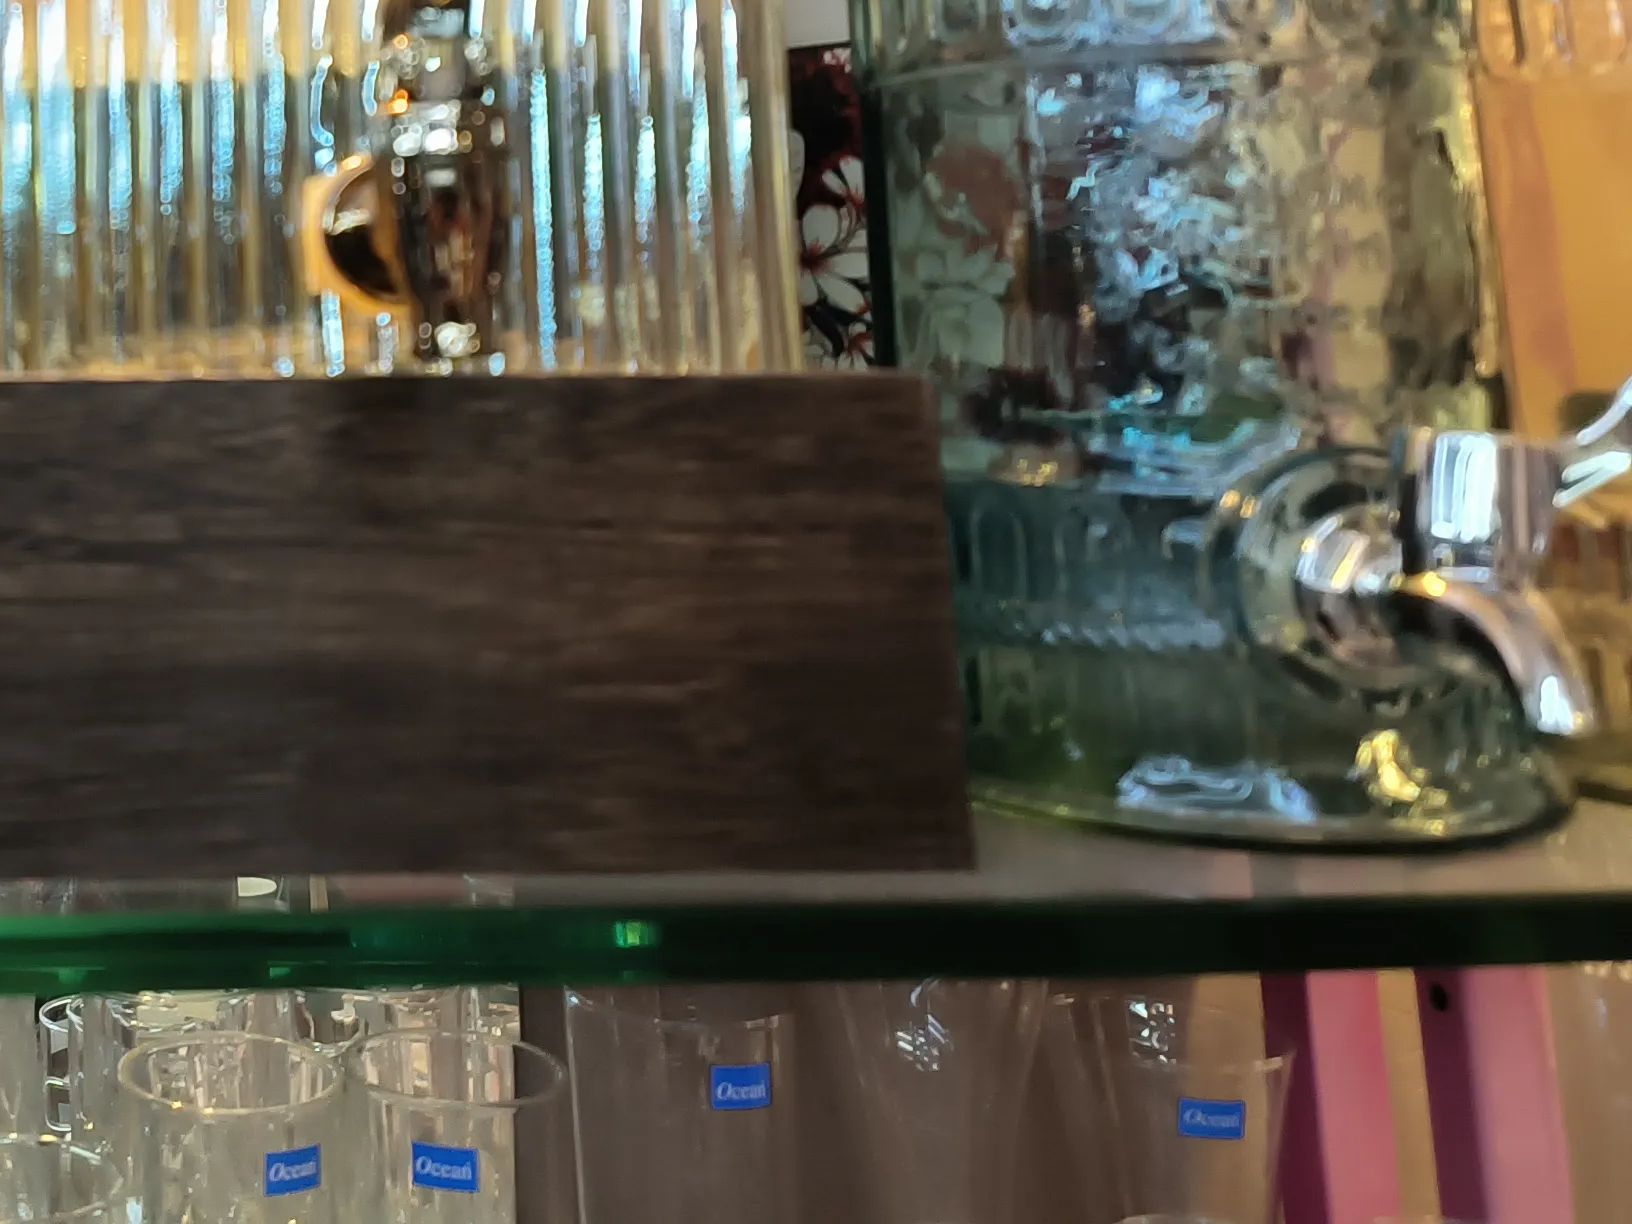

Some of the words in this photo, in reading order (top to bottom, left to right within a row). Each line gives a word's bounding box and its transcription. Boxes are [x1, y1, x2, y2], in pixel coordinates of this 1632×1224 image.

[716, 1080, 766, 1100] Ocean
[269, 1161, 317, 1182] Ocean
[416, 1155, 472, 1180] Ocean
